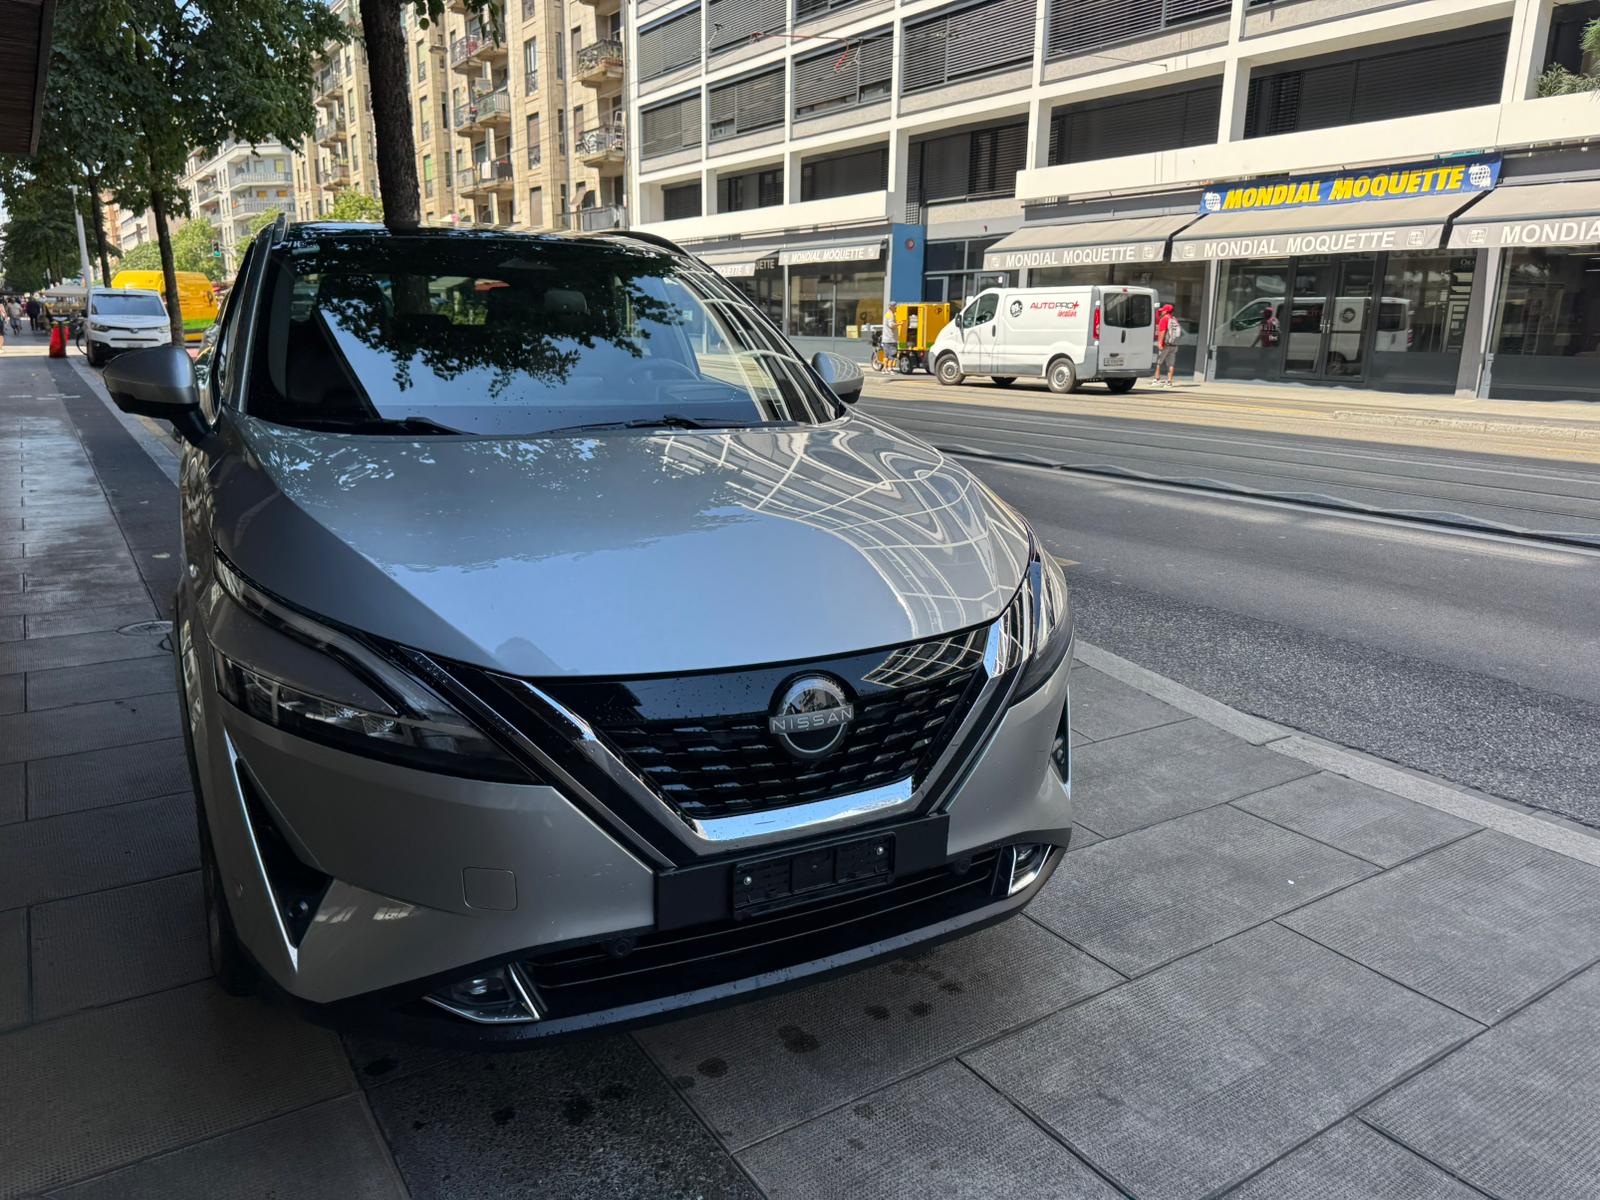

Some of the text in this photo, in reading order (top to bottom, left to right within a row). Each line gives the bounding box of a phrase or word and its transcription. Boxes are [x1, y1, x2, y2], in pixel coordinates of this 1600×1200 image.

[1222, 164, 1467, 210] MONDIAL MOQUETTE
[791, 247, 865, 264] MONDIAL MOQUETTE
[1203, 238, 1280, 258] MONDIAL
[1286, 230, 1396, 254] MOQUETTE
[1005, 246, 1136, 268] MONDIAL MOQUETTE
[772, 707, 853, 731] NISSAN
